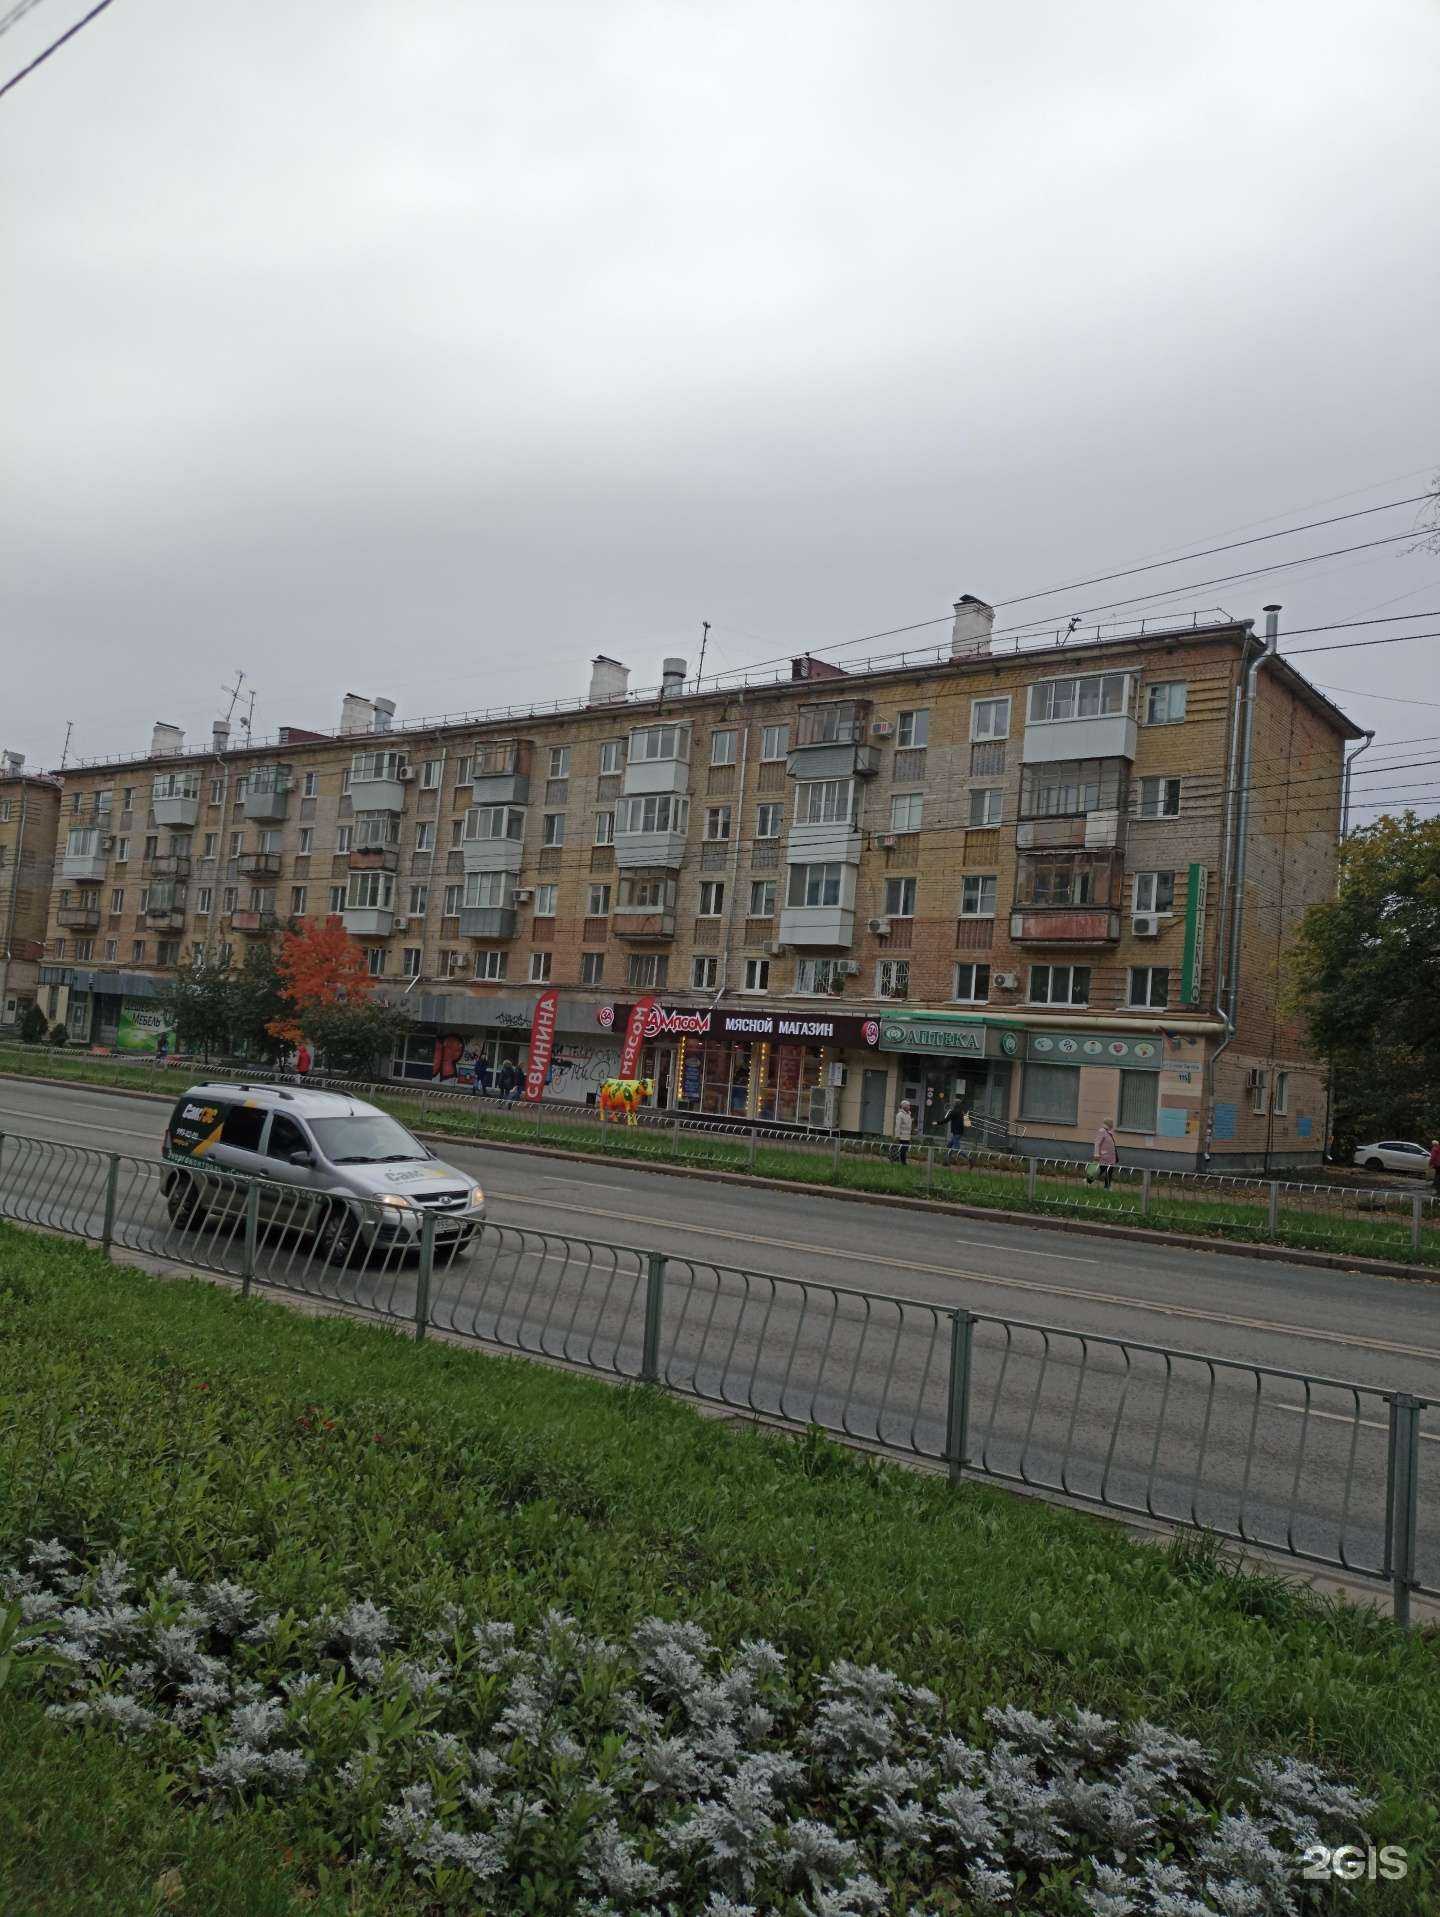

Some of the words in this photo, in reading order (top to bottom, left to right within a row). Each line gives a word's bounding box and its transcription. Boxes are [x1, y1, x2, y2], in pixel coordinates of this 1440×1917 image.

[527, 999, 554, 1098] СВИНИНА
[622, 1007, 648, 1075] МЯСОМ
[725, 1017, 774, 1033] МЯСНОЙ
[778, 1021, 834, 1037] МАГАЗИН
[906, 1029, 980, 1050] АПТЕКА
